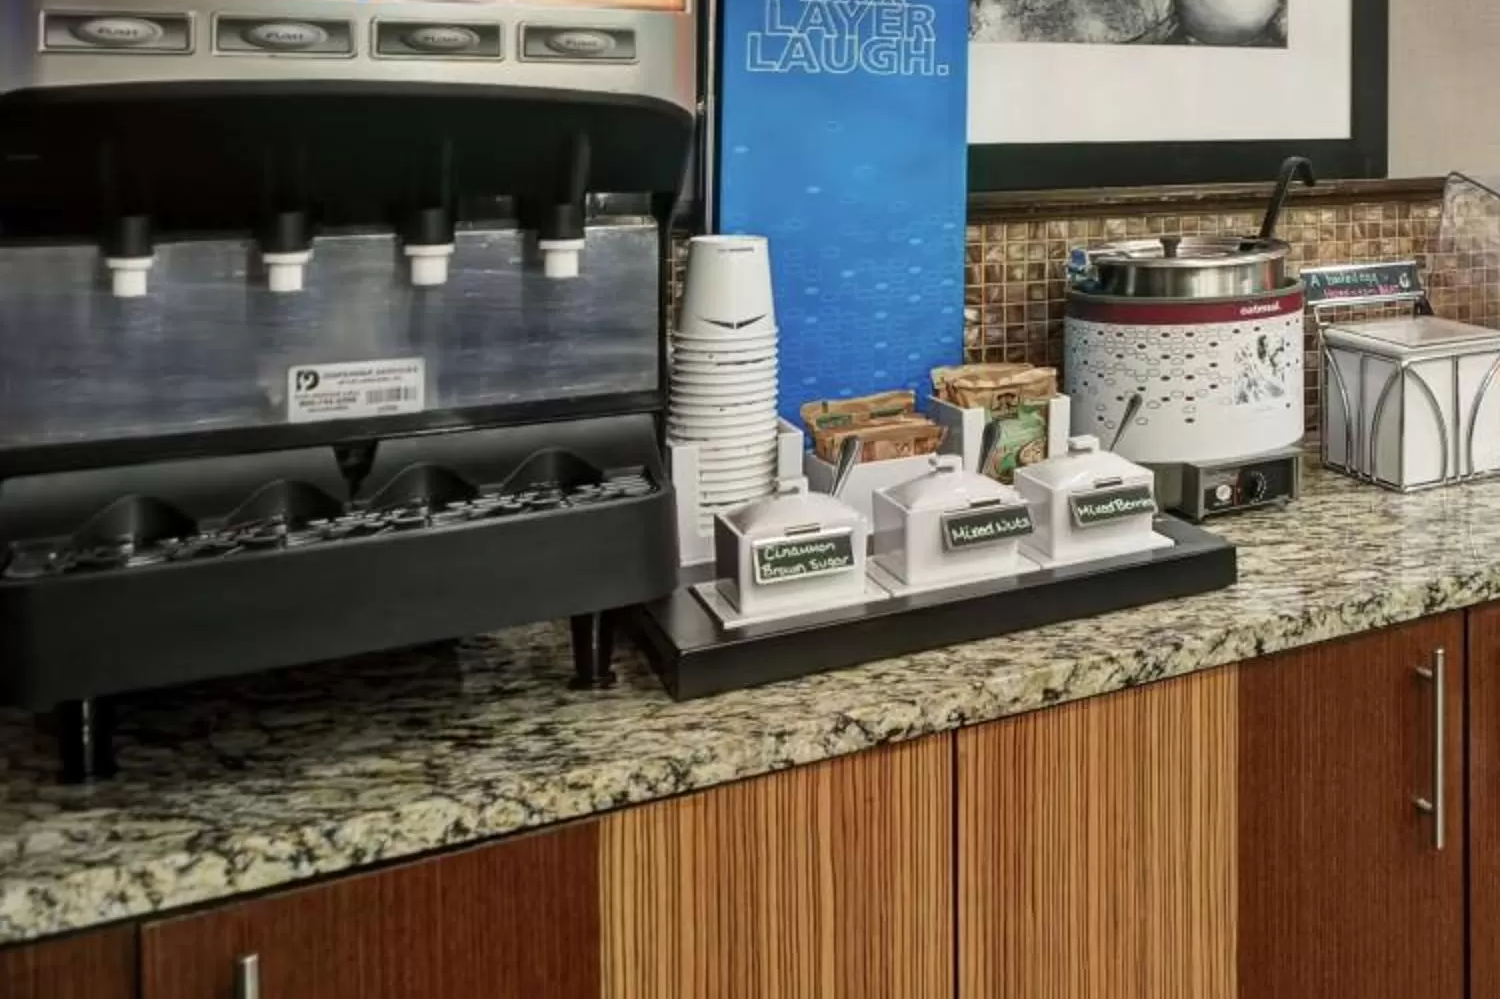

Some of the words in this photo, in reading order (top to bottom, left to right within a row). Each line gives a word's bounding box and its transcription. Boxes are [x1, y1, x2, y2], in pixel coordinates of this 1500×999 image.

[746, 32, 950, 76] LAUGH.
[1077, 500, 1115, 517] Mixed
[951, 522, 995, 542] Mixed
